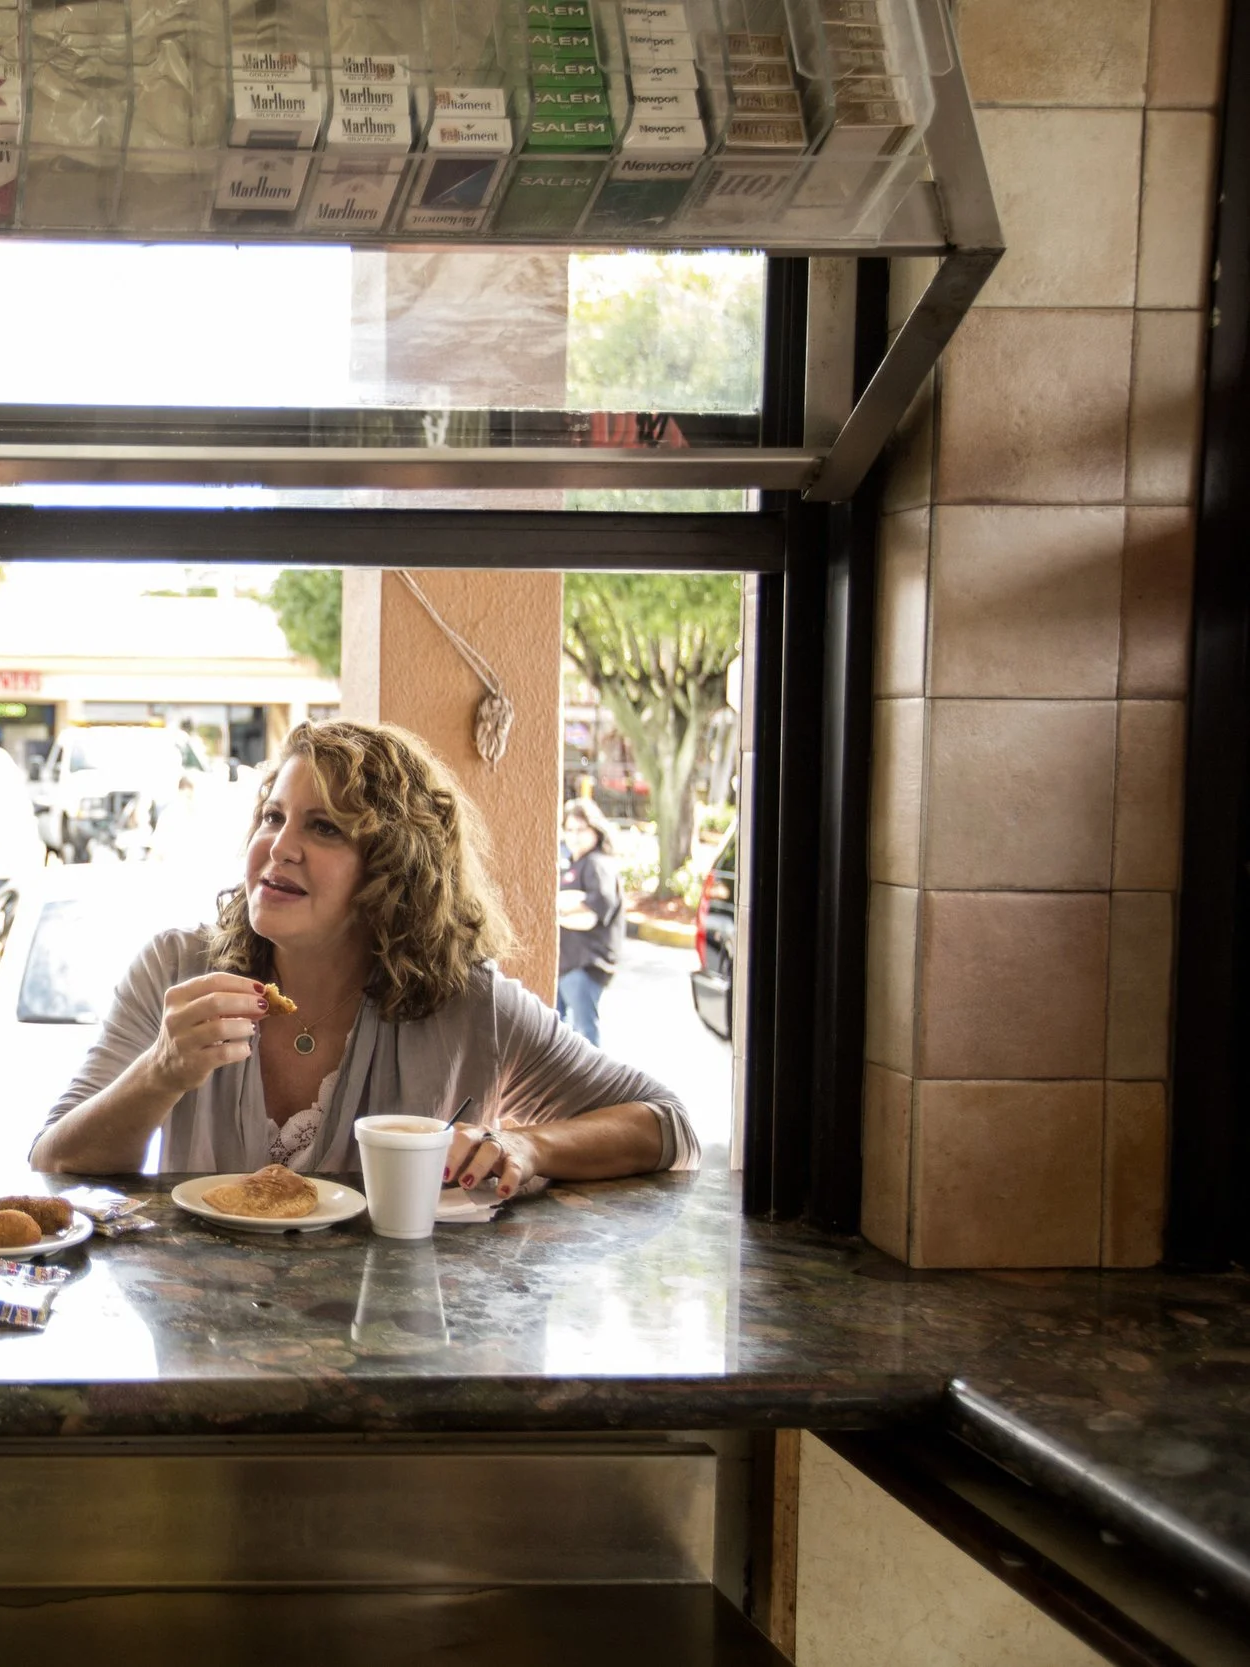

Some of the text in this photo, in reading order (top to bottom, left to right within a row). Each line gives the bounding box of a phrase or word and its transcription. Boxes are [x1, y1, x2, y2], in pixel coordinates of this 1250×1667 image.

[527, 5, 585, 16] ALEM
[623, 7, 667, 18] Newport
[531, 36, 590, 46] ALEM
[340, 87, 393, 105] Marlboro
[635, 95, 679, 105] Newport
[251, 93, 306, 111] Marlboro
[342, 117, 396, 135] Marlboro
[532, 123, 605, 133] SALEM
[639, 124, 686, 135] Newport
[622, 160, 695, 173] Newport
[230, 176, 292, 199] Marlboro
[519, 177, 591, 187] SALEM
[317, 199, 379, 221] Marlboro
